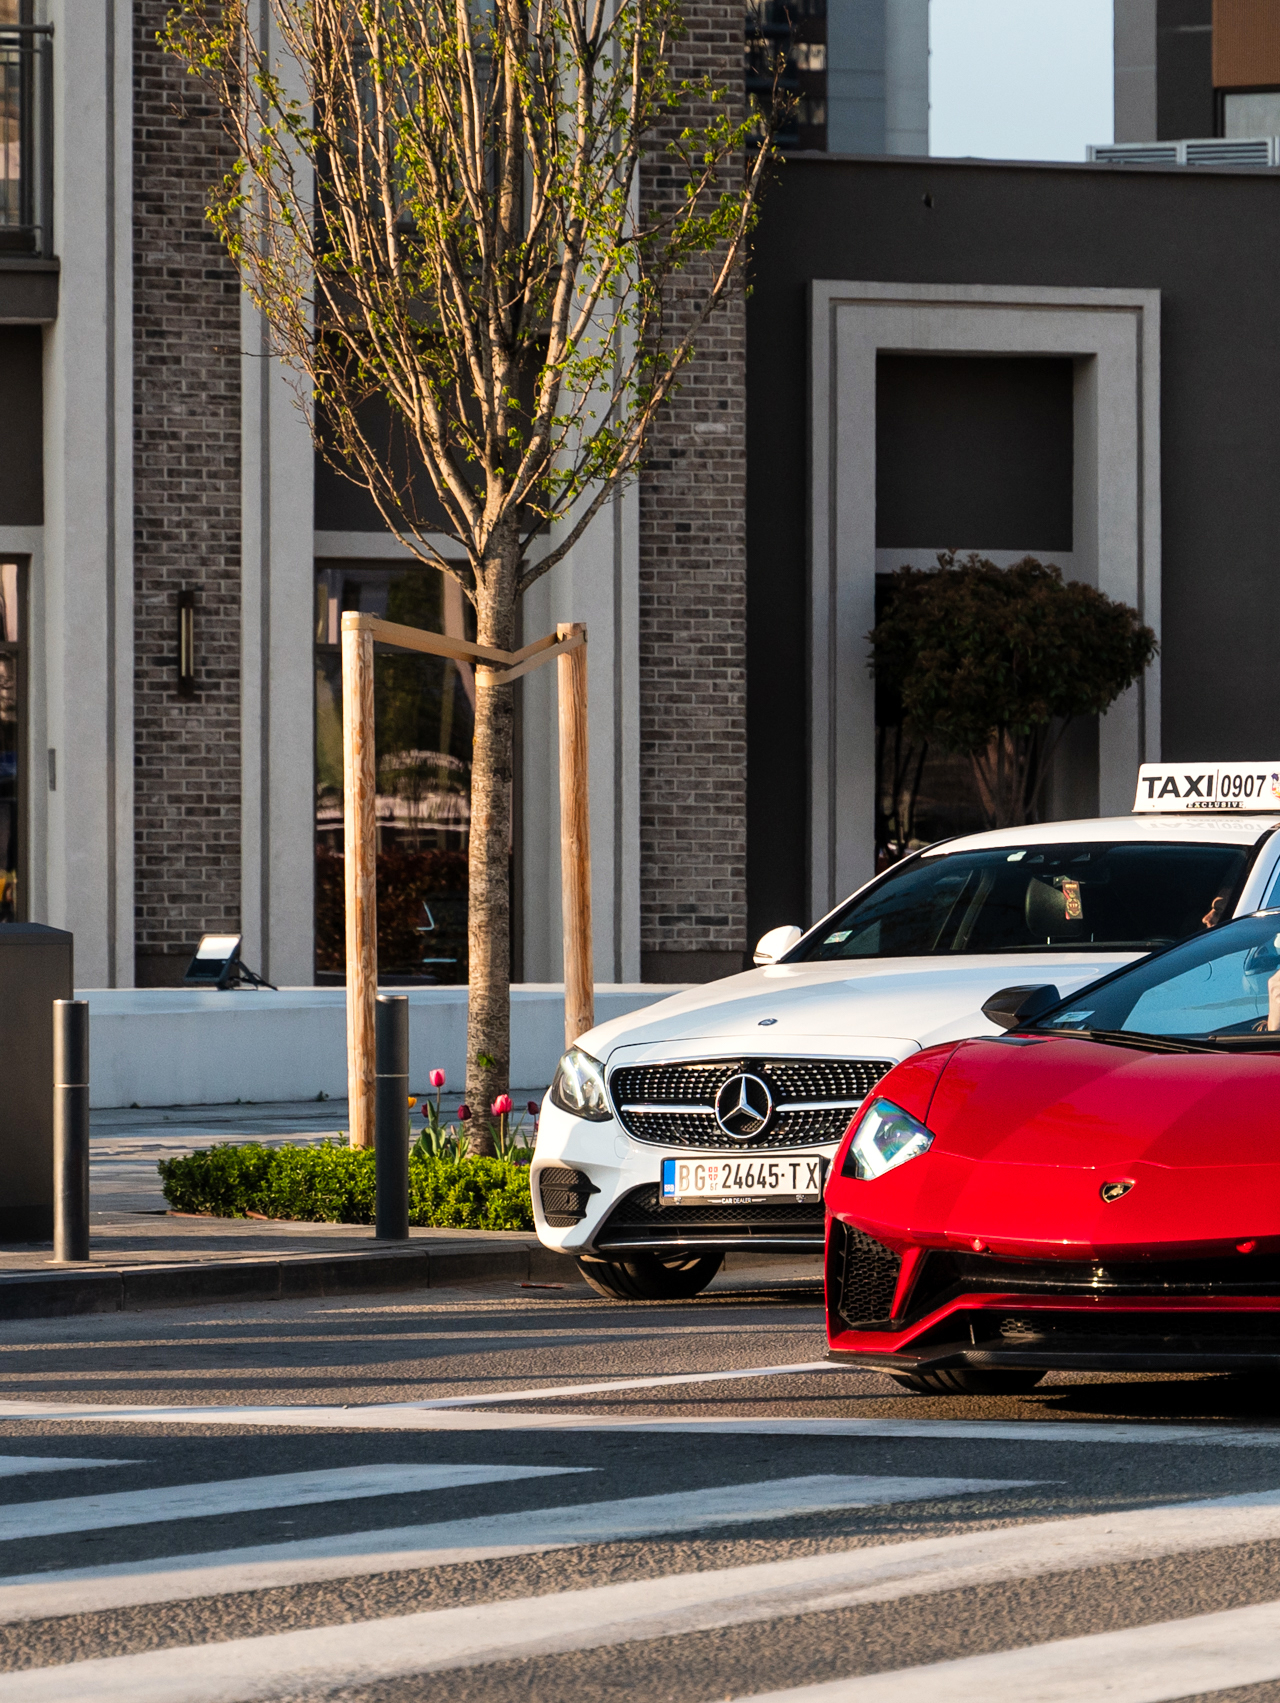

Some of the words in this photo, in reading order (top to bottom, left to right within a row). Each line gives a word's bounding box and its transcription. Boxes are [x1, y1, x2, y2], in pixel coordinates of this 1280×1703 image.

[1142, 774, 1214, 799] TAXI
[1220, 774, 1267, 798] 0907
[1187, 801, 1245, 809] EXCLUSIVE
[678, 1164, 706, 1192] BG
